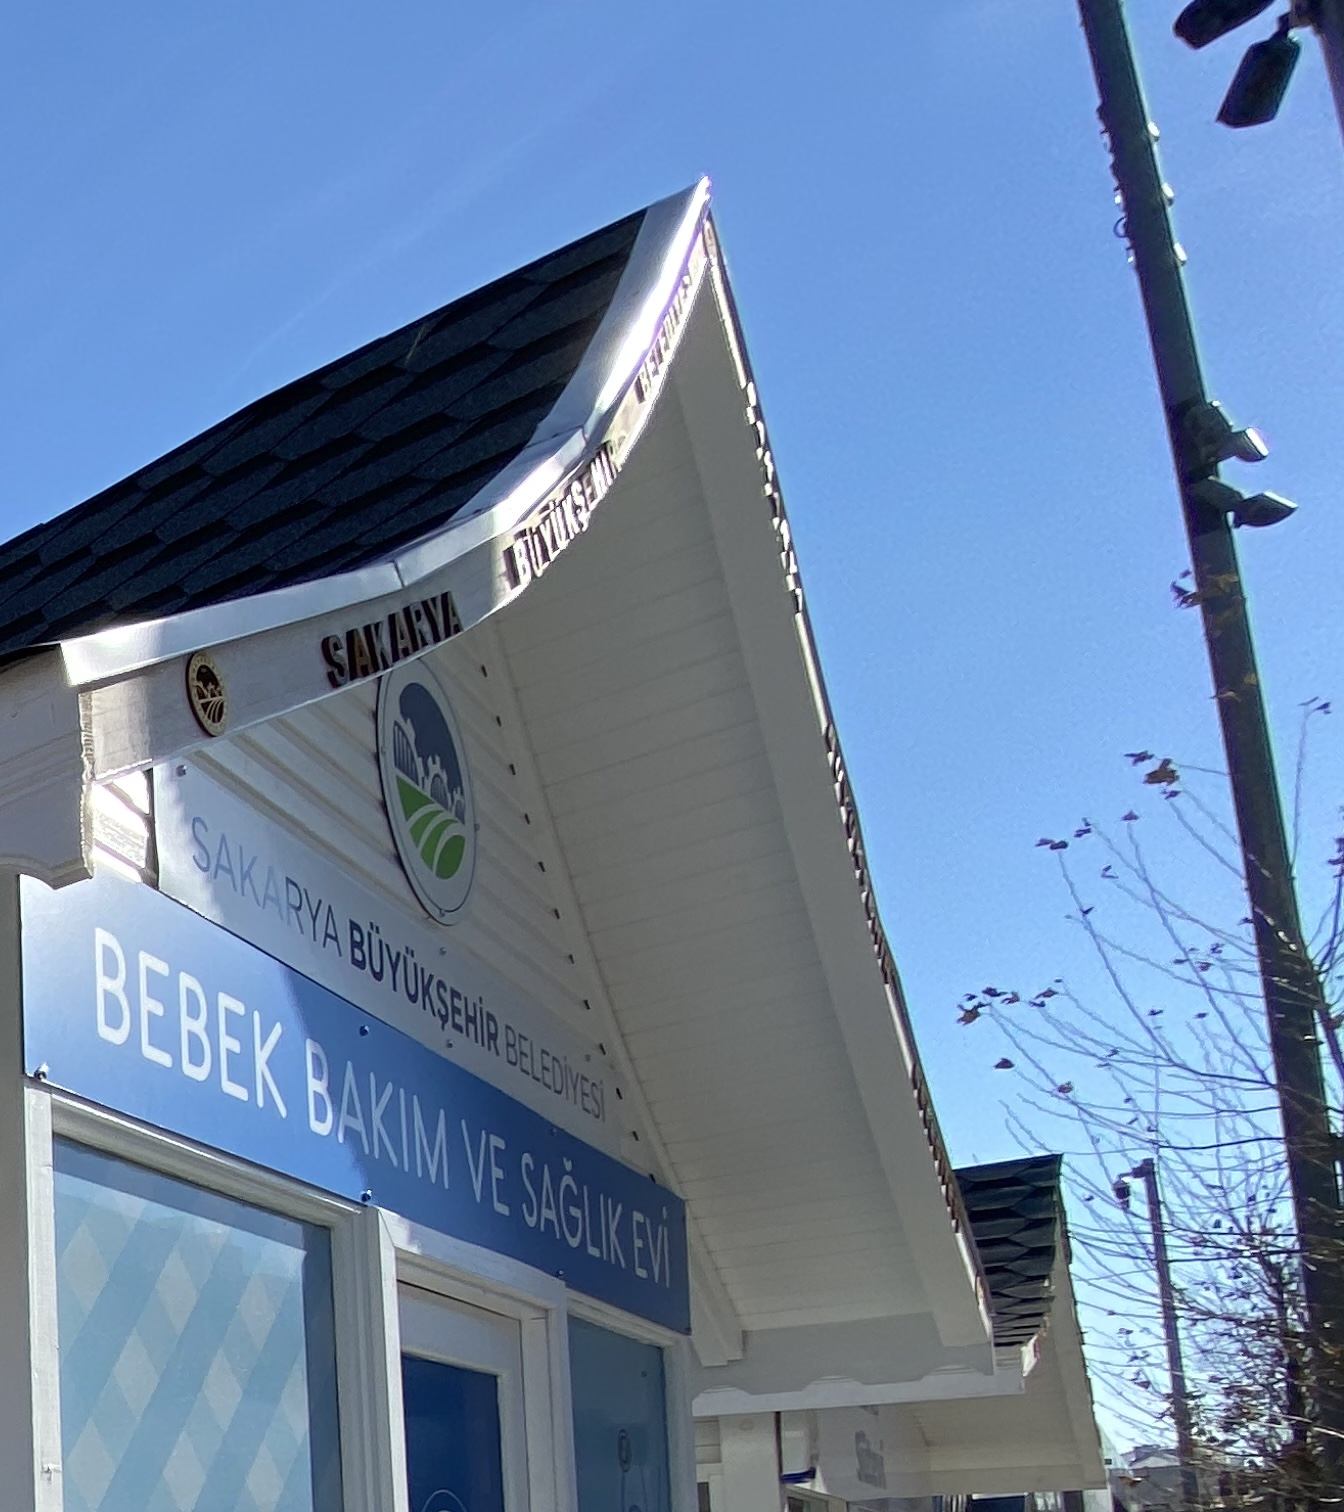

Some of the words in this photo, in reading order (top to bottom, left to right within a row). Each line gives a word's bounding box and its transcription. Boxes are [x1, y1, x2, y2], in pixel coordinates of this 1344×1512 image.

[321, 590, 463, 688] SAKARYA
[95, 927, 287, 1118] BEBEK
[305, 1038, 449, 1190] BAKIM
[462, 1118, 511, 1218] VE
[520, 1158, 626, 1270] SAĞLIK
[632, 1209, 673, 1288] EVİ
[191, 816, 343, 958] SAKARYA
[349, 918, 500, 1057] BÜYÜKŞEHİR
[504, 1023, 606, 1122] BELEDİYESİ
